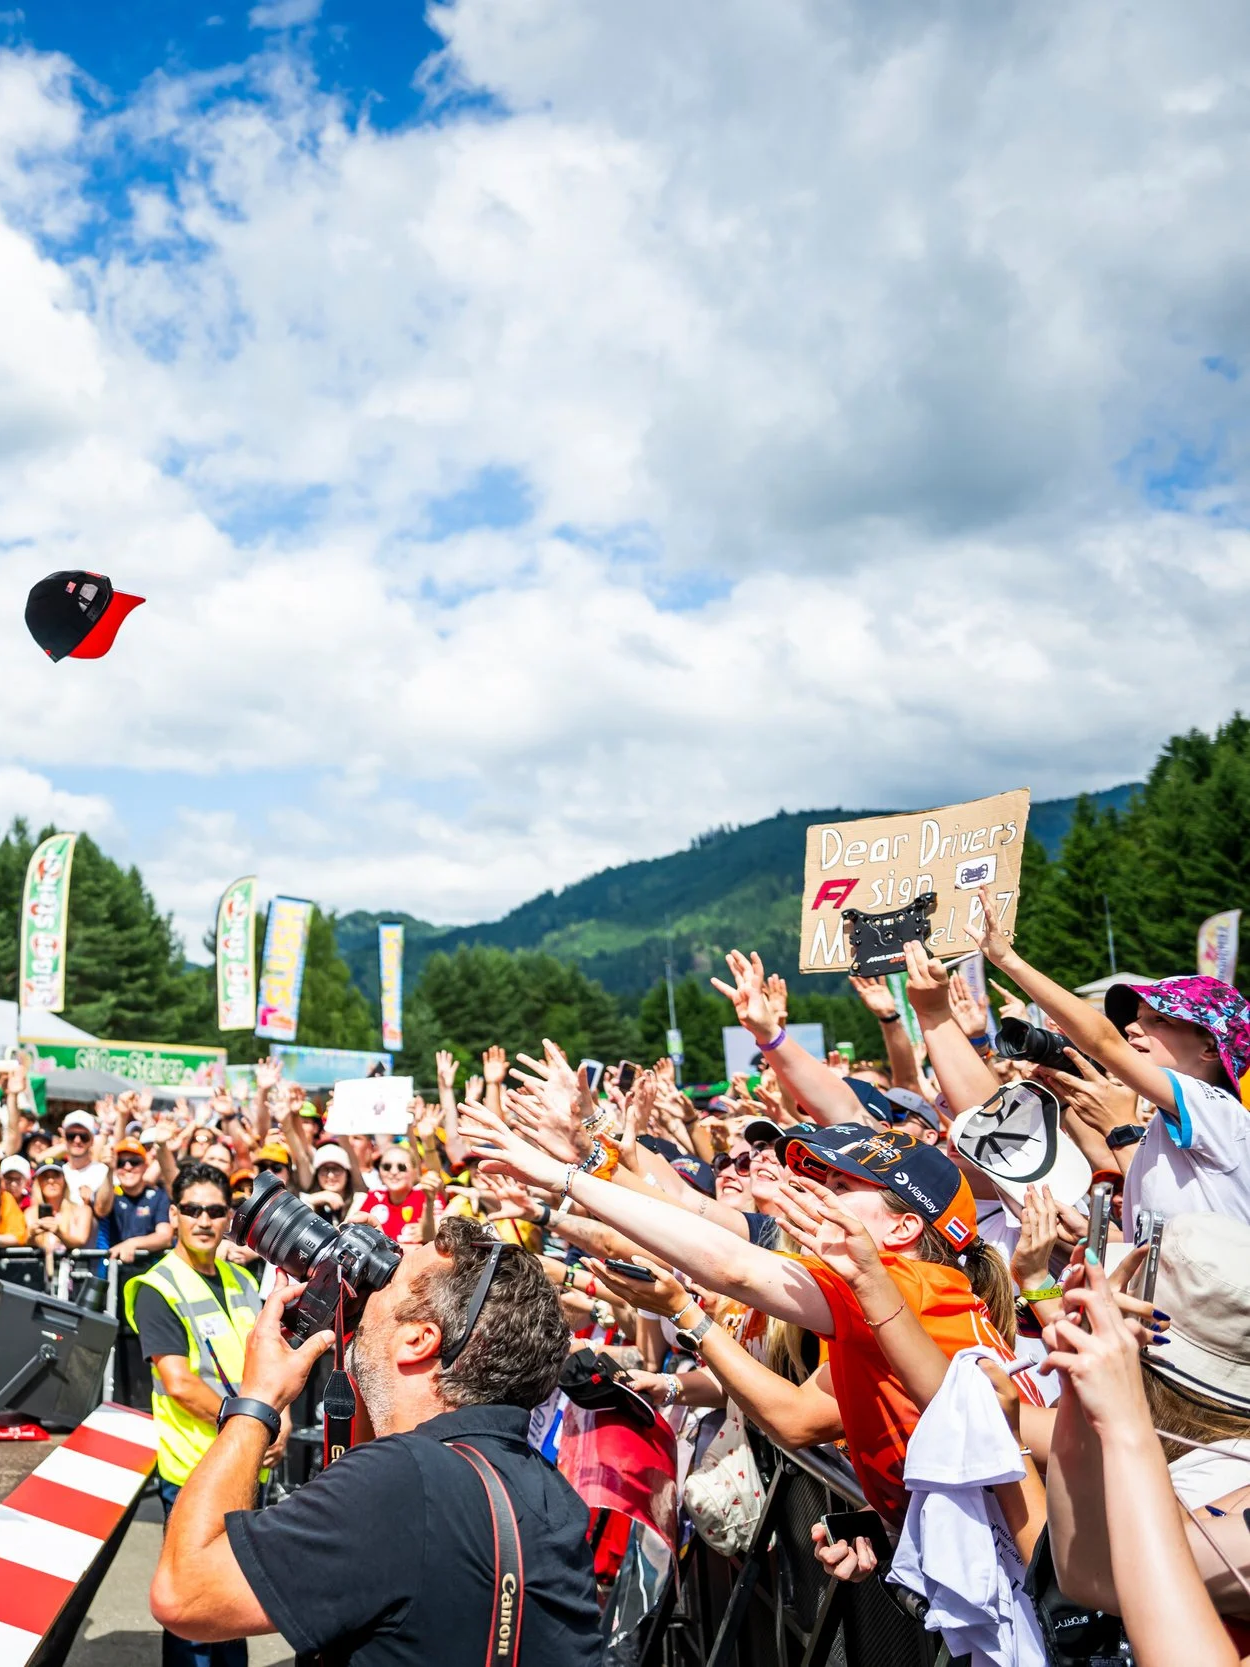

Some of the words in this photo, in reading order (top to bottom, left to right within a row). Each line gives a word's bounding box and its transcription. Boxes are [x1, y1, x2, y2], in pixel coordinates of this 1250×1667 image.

[821, 828, 909, 871] Dear
[919, 819, 1018, 868] Drivers
[811, 878, 860, 911] F1
[868, 869, 934, 909] sign
[267, 905, 303, 1008] SLUSH
[907, 1182, 940, 1214] viaplay
[498, 1572, 517, 1656] Canon
